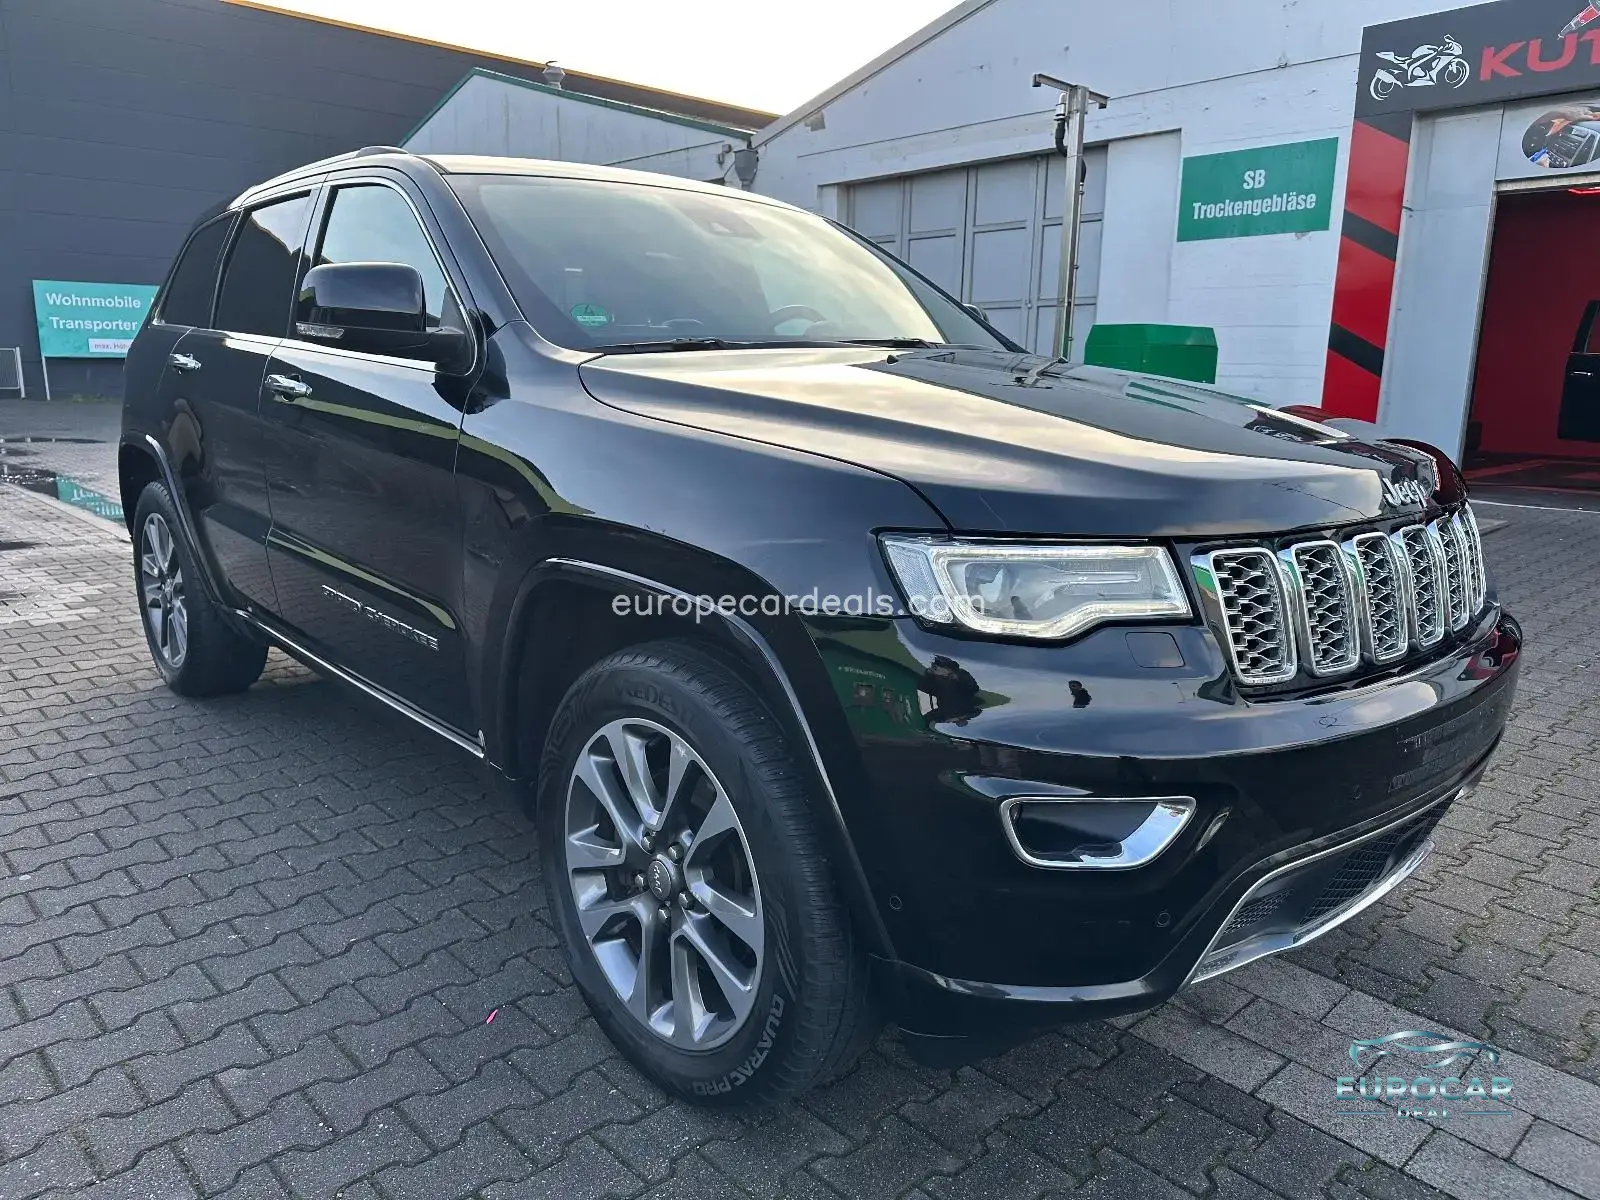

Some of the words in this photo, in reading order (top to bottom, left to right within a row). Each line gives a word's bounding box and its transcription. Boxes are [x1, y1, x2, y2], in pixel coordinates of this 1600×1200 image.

[1242, 169, 1267, 190] SB
[1192, 192, 1317, 220] Trockengebläse
[45, 292, 142, 309] Wohnmobile
[49, 316, 138, 332] Transporter
[1382, 477, 1428, 510] Jeep
[734, 993, 785, 1087] QUATRAC
[692, 1081, 733, 1096] PRO
